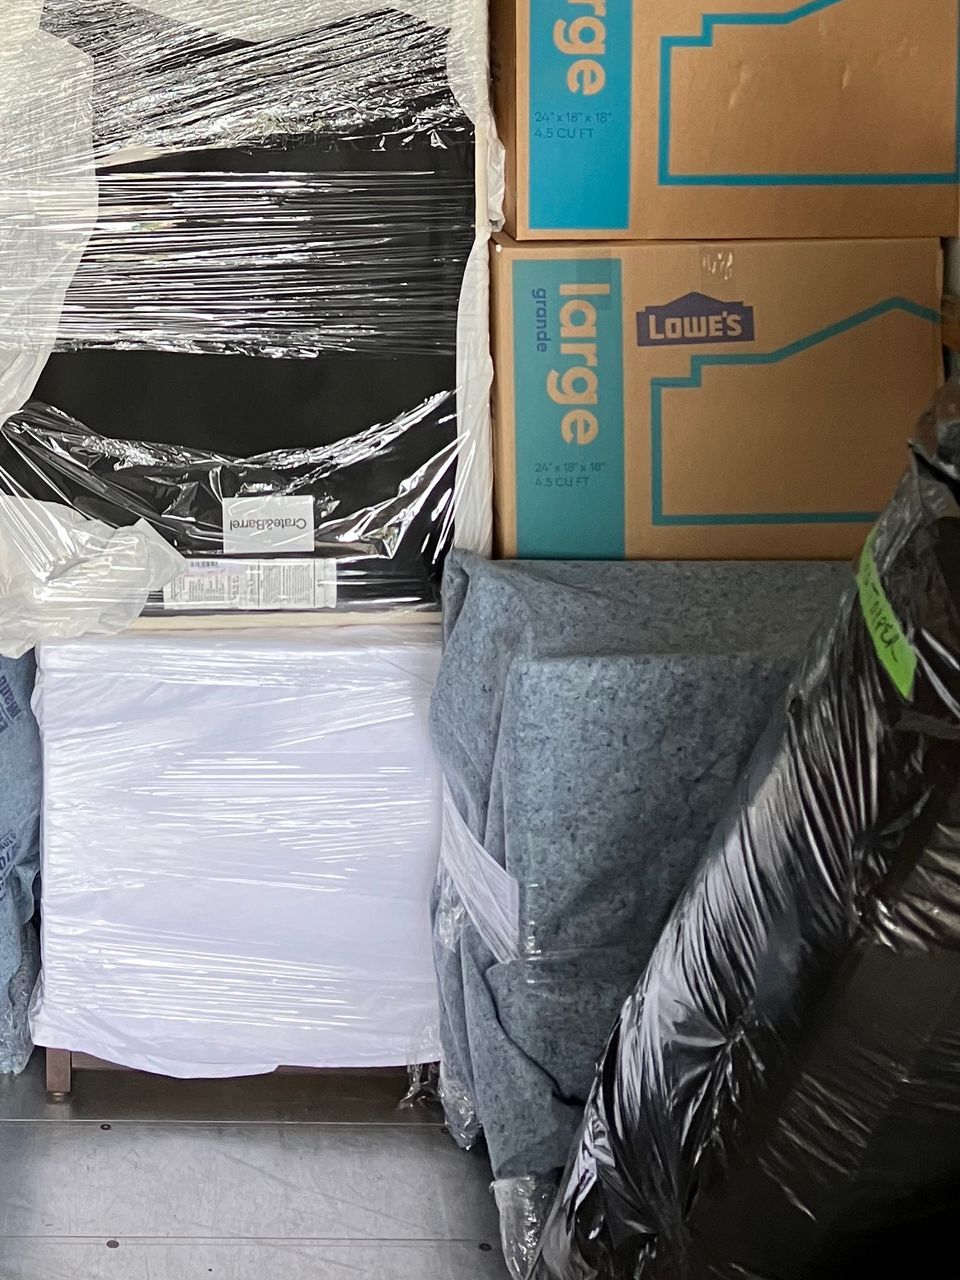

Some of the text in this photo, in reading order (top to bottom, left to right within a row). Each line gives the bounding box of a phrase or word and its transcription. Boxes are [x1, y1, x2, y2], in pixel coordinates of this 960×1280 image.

[557, 127, 576, 138] CU
[580, 128, 594, 138] FT
[532, 288, 552, 353] grande
[648, 311, 743, 340] LOWE'S
[547, 283, 610, 446] large
[555, 477, 573, 488] CU
[576, 476, 590, 487] FT
[229, 518, 307, 532] Crate&Barrel
